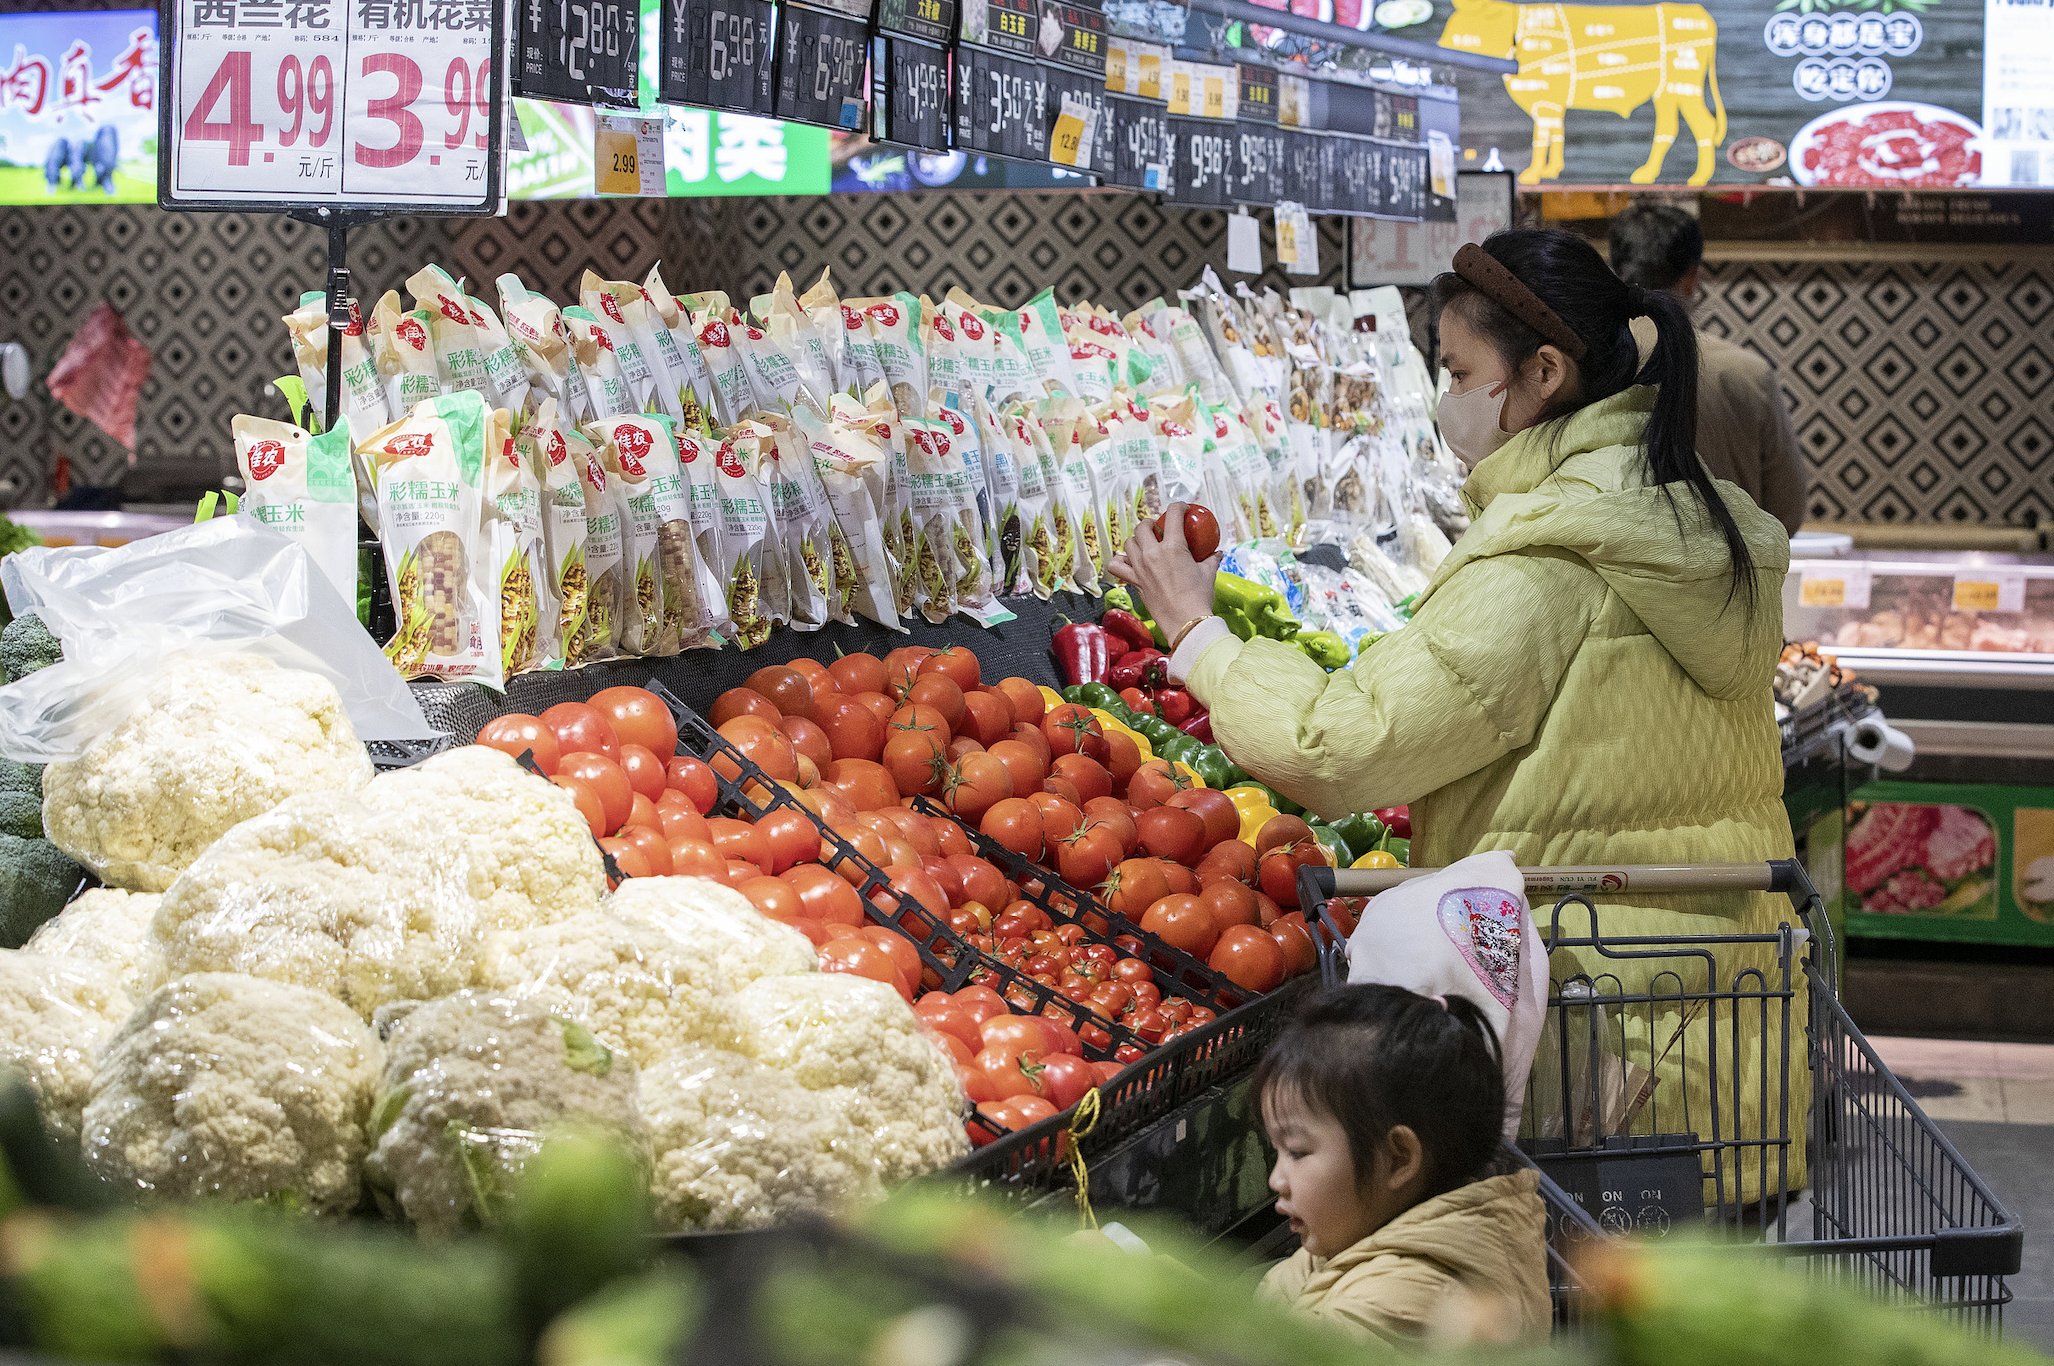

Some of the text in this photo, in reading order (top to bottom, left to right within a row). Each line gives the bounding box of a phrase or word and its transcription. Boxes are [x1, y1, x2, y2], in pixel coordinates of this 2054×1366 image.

[193, 0, 331, 29] 西兰花
[358, 0, 492, 32] 有机花菜
[526, 63, 542, 75] PRICE
[185, 51, 334, 166] 4.99
[299, 157, 334, 178] 元/斤
[465, 160, 488, 181] 元/
[613, 153, 635, 174] 2.99
[249, 448, 279, 469] 佳农
[389, 481, 459, 501] 彩糯玉米
[652, 473, 682, 495] 玉米
[425, 511, 445, 521] 220g
[721, 497, 764, 515] 彩糯玉
